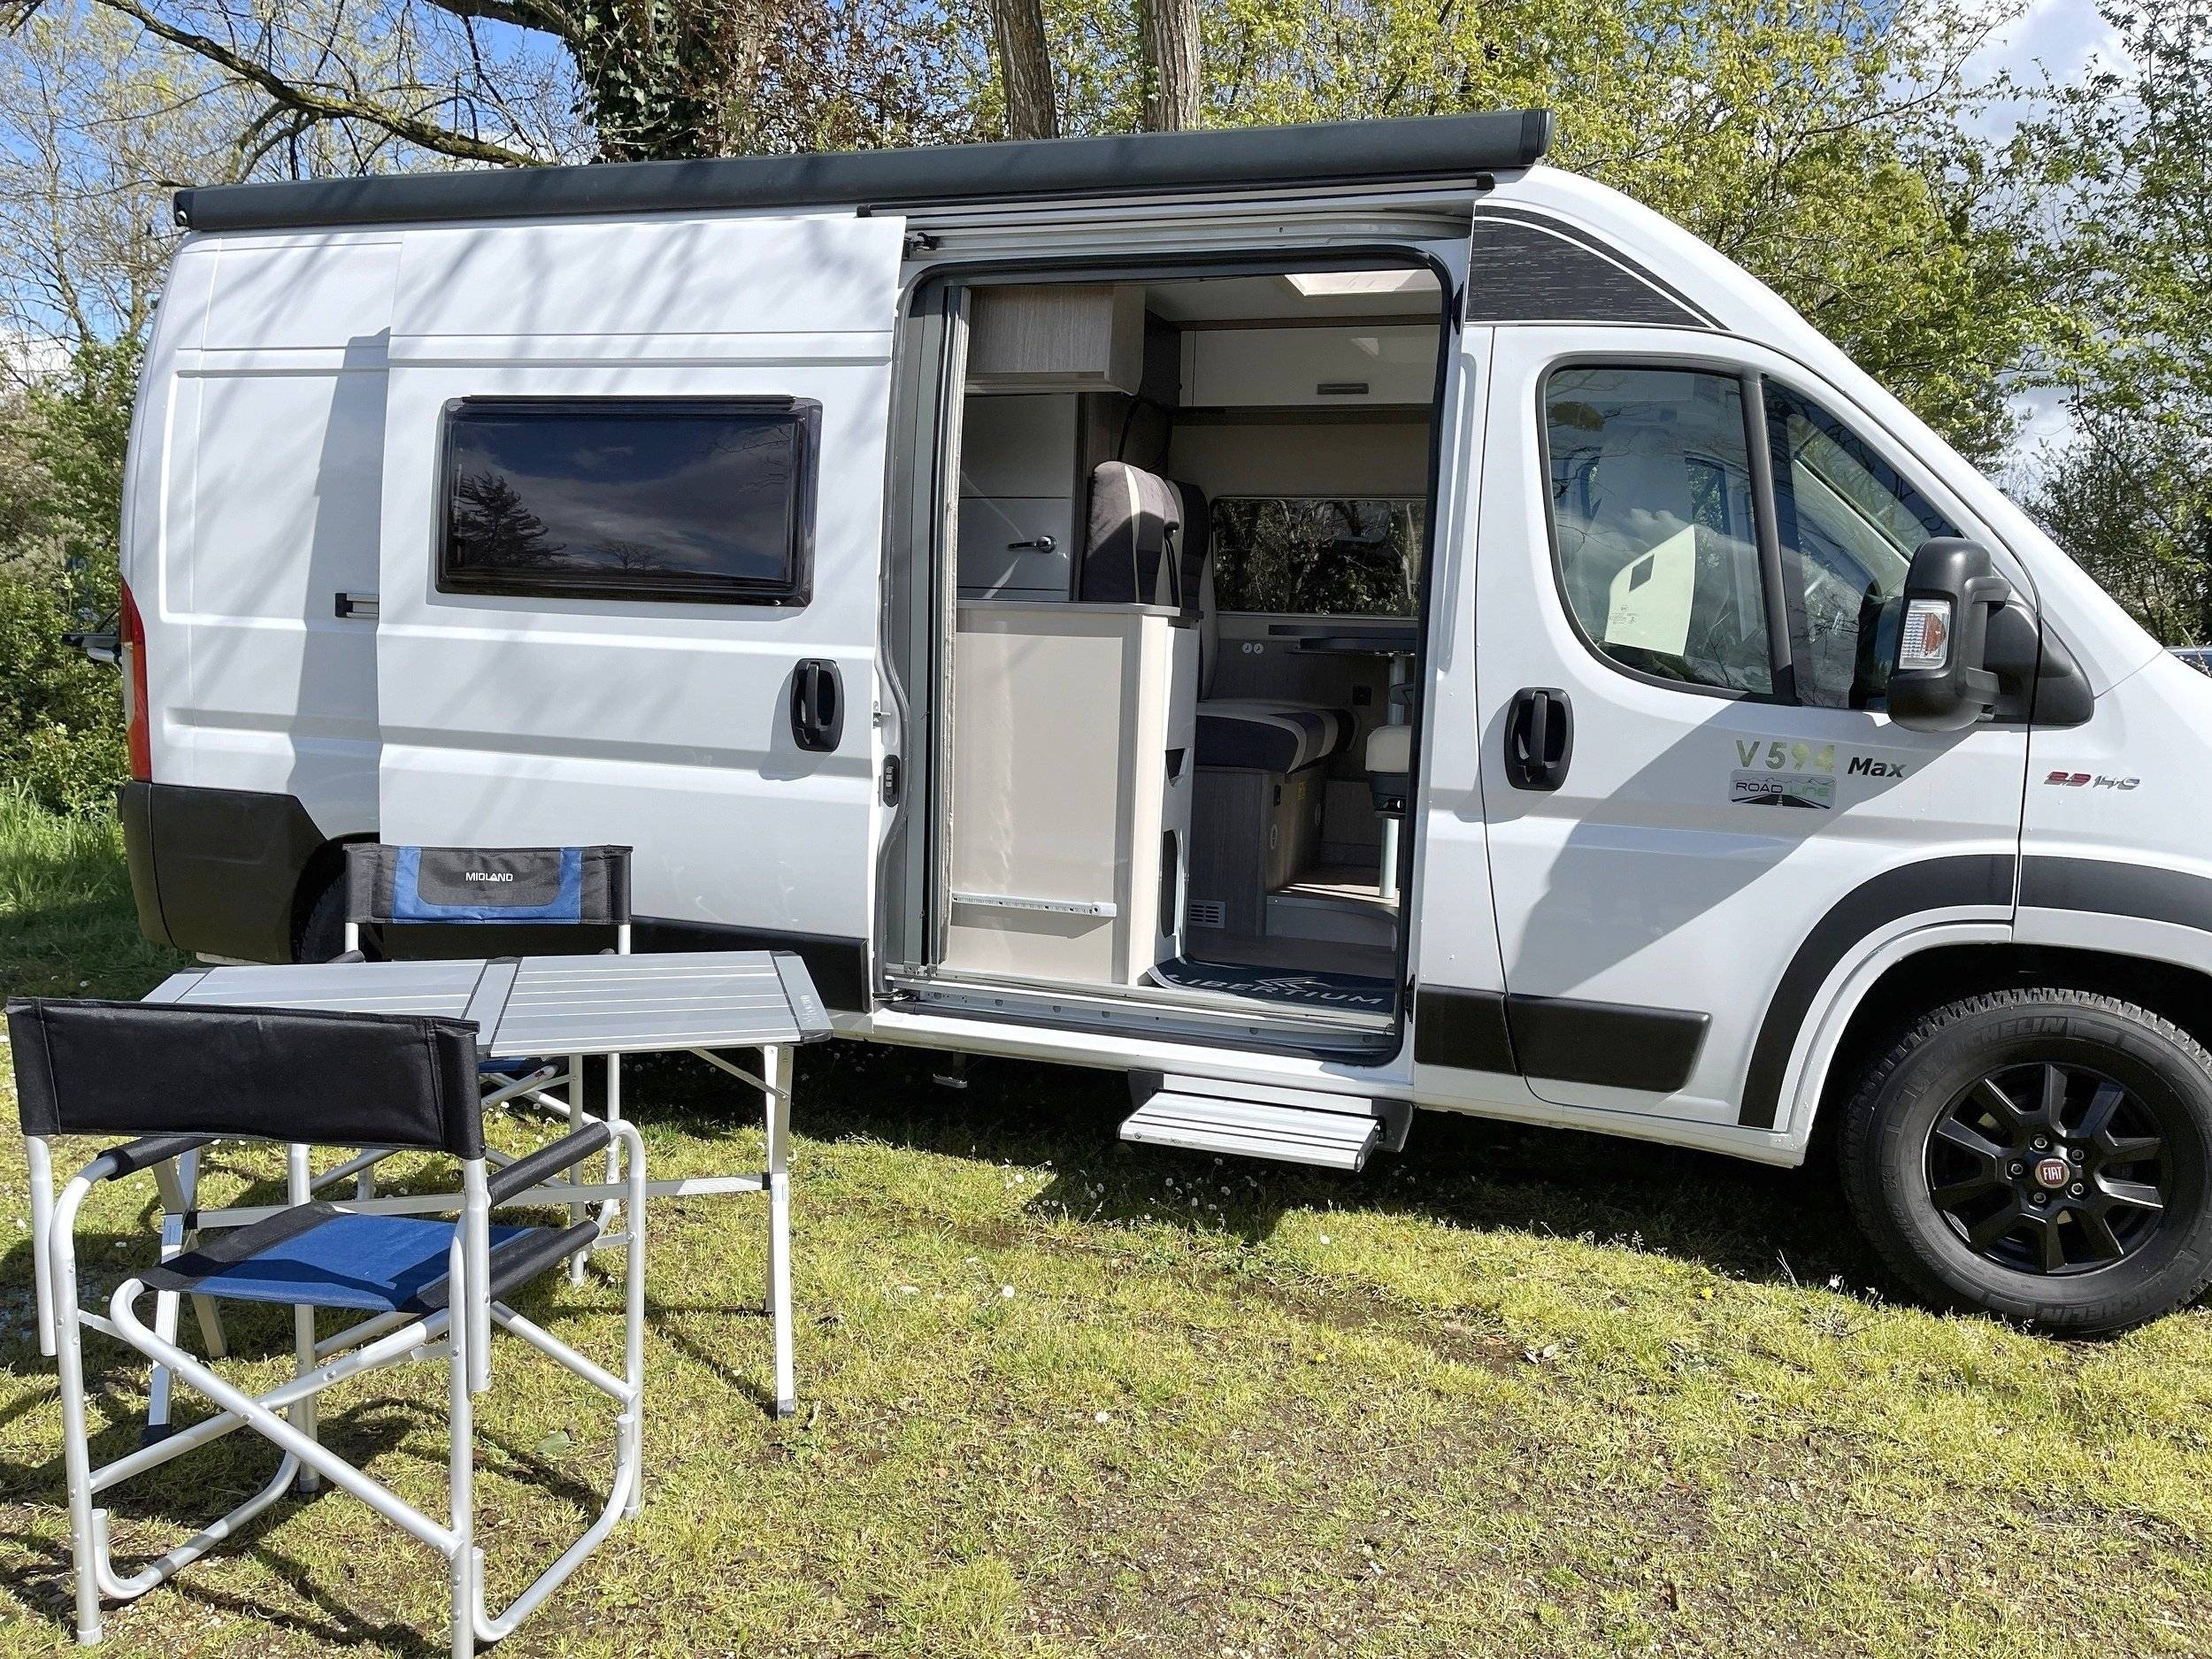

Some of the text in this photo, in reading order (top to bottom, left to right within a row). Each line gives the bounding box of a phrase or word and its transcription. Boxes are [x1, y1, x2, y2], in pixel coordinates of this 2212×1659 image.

[1735, 740, 1908, 778] V 594 Max
[1735, 782, 1784, 795] ROAD
[465, 872, 513, 882] MIDLAND
[1164, 974, 1384, 1005] LIBERTIUM
[2043, 1166, 2062, 1180] FIAT
